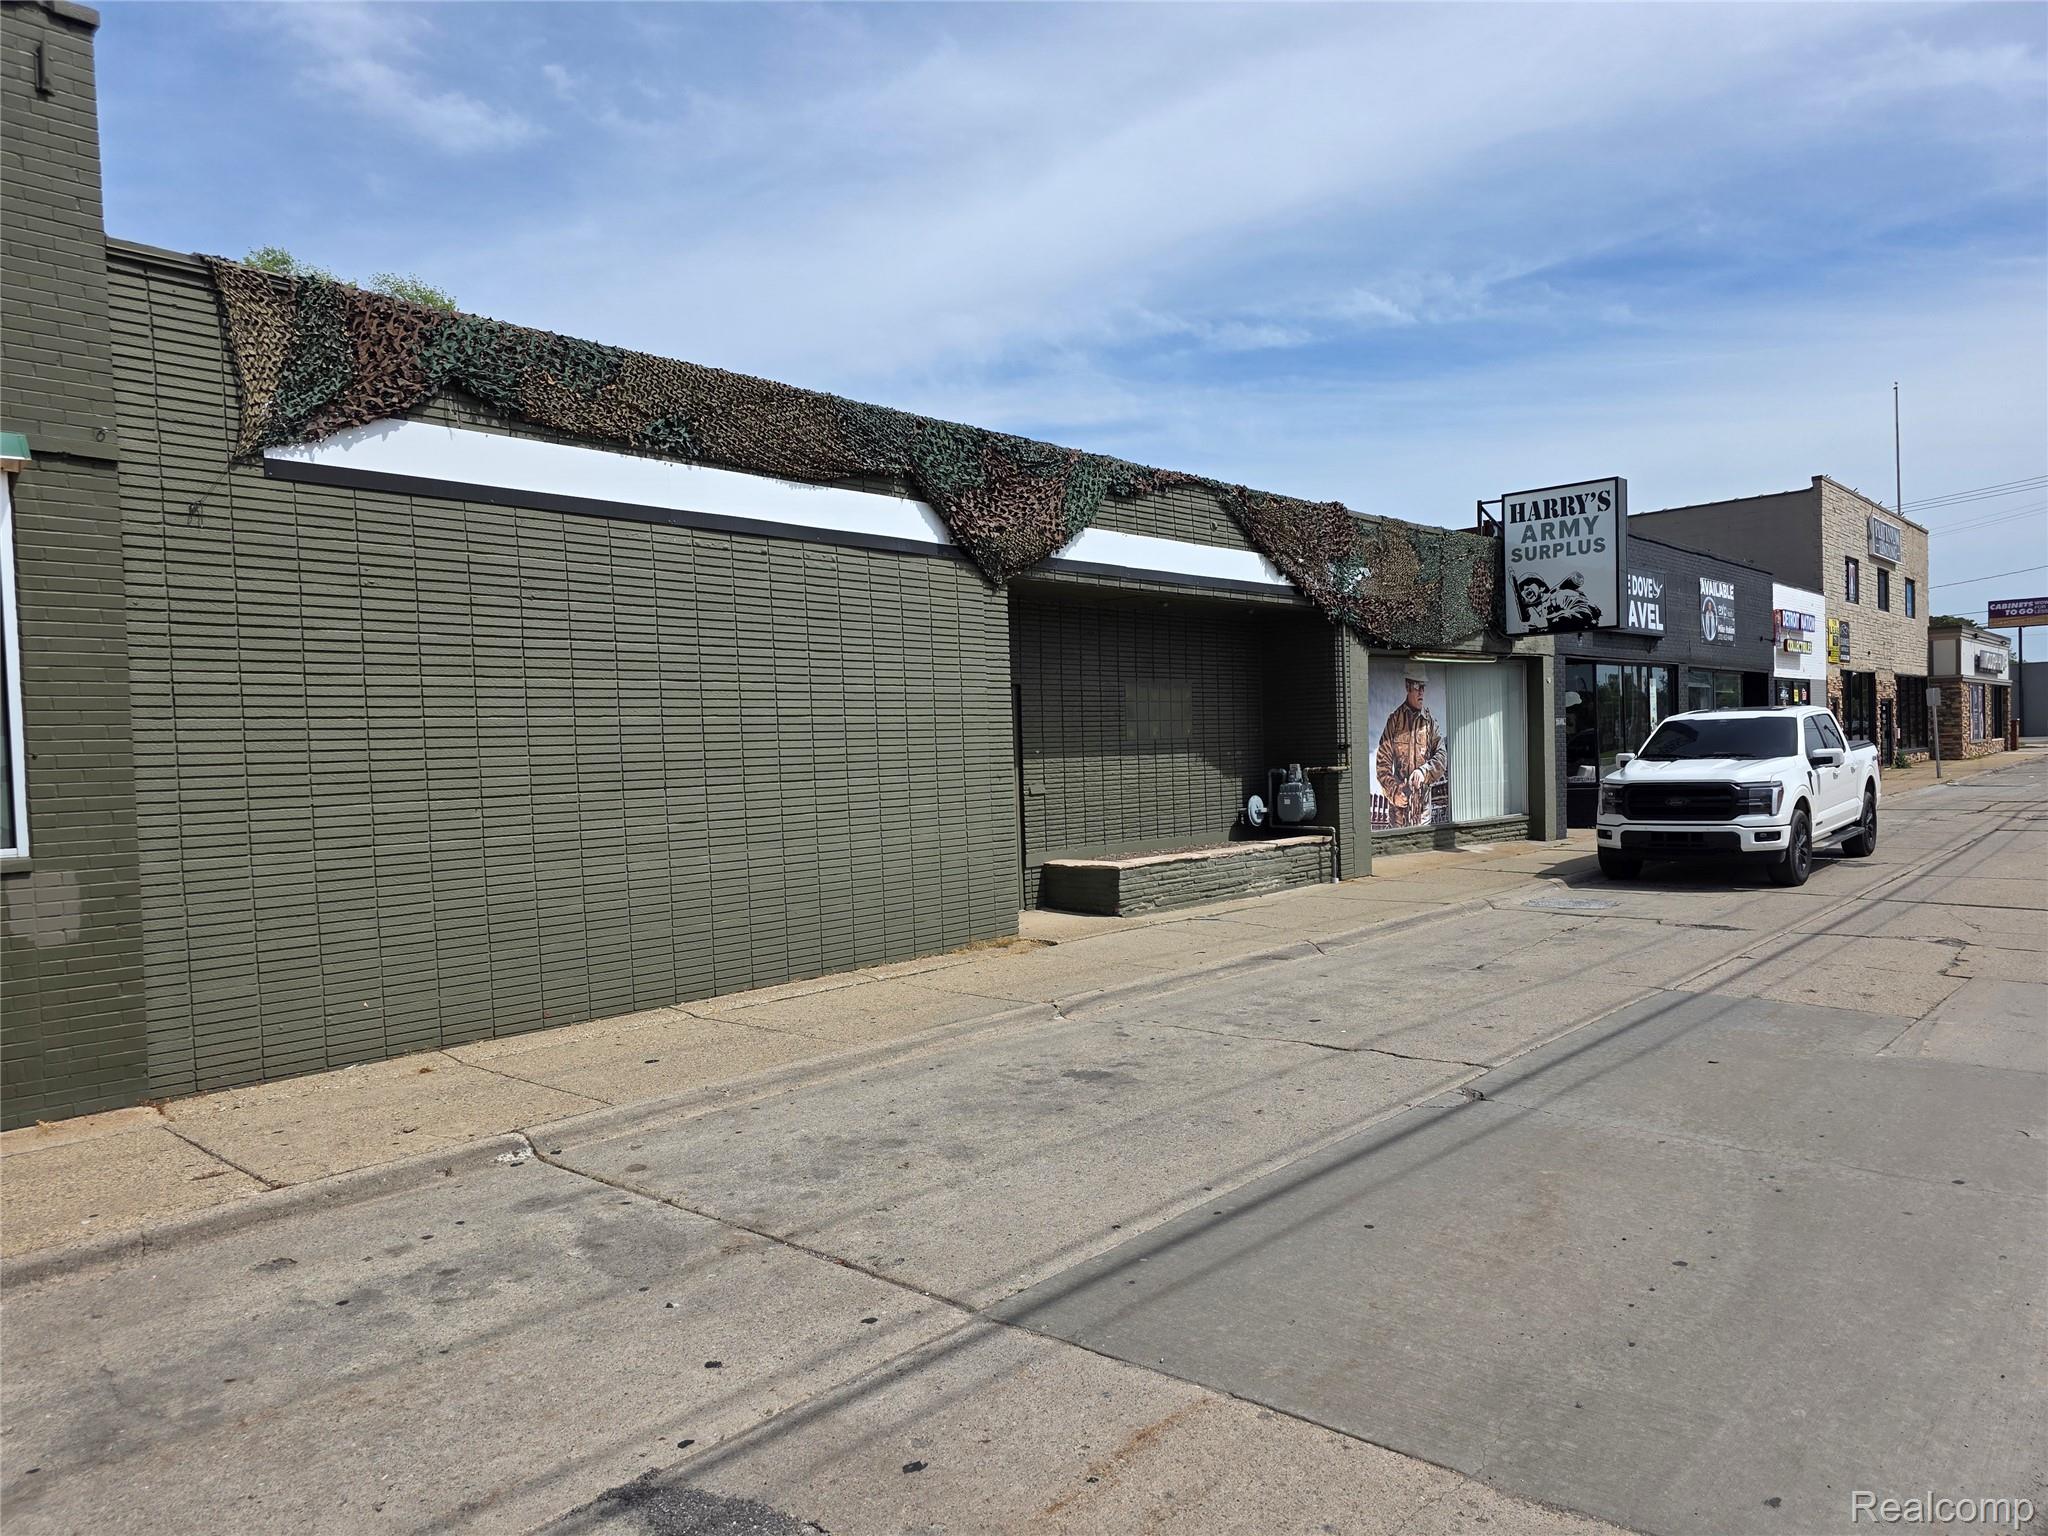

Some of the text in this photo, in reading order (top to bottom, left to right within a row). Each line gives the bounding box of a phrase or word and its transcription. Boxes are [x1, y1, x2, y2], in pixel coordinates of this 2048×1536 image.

[1509, 489, 1611, 524] HARRY'S
[1521, 515, 1600, 544] ARMY
[1511, 537, 1606, 563] SURPLUS
[1632, 575, 1653, 598] DOVE
[1700, 578, 1734, 600] AVAILABLE
[1628, 600, 1663, 630] AVEL
[1990, 601, 2034, 610] CABINETS
